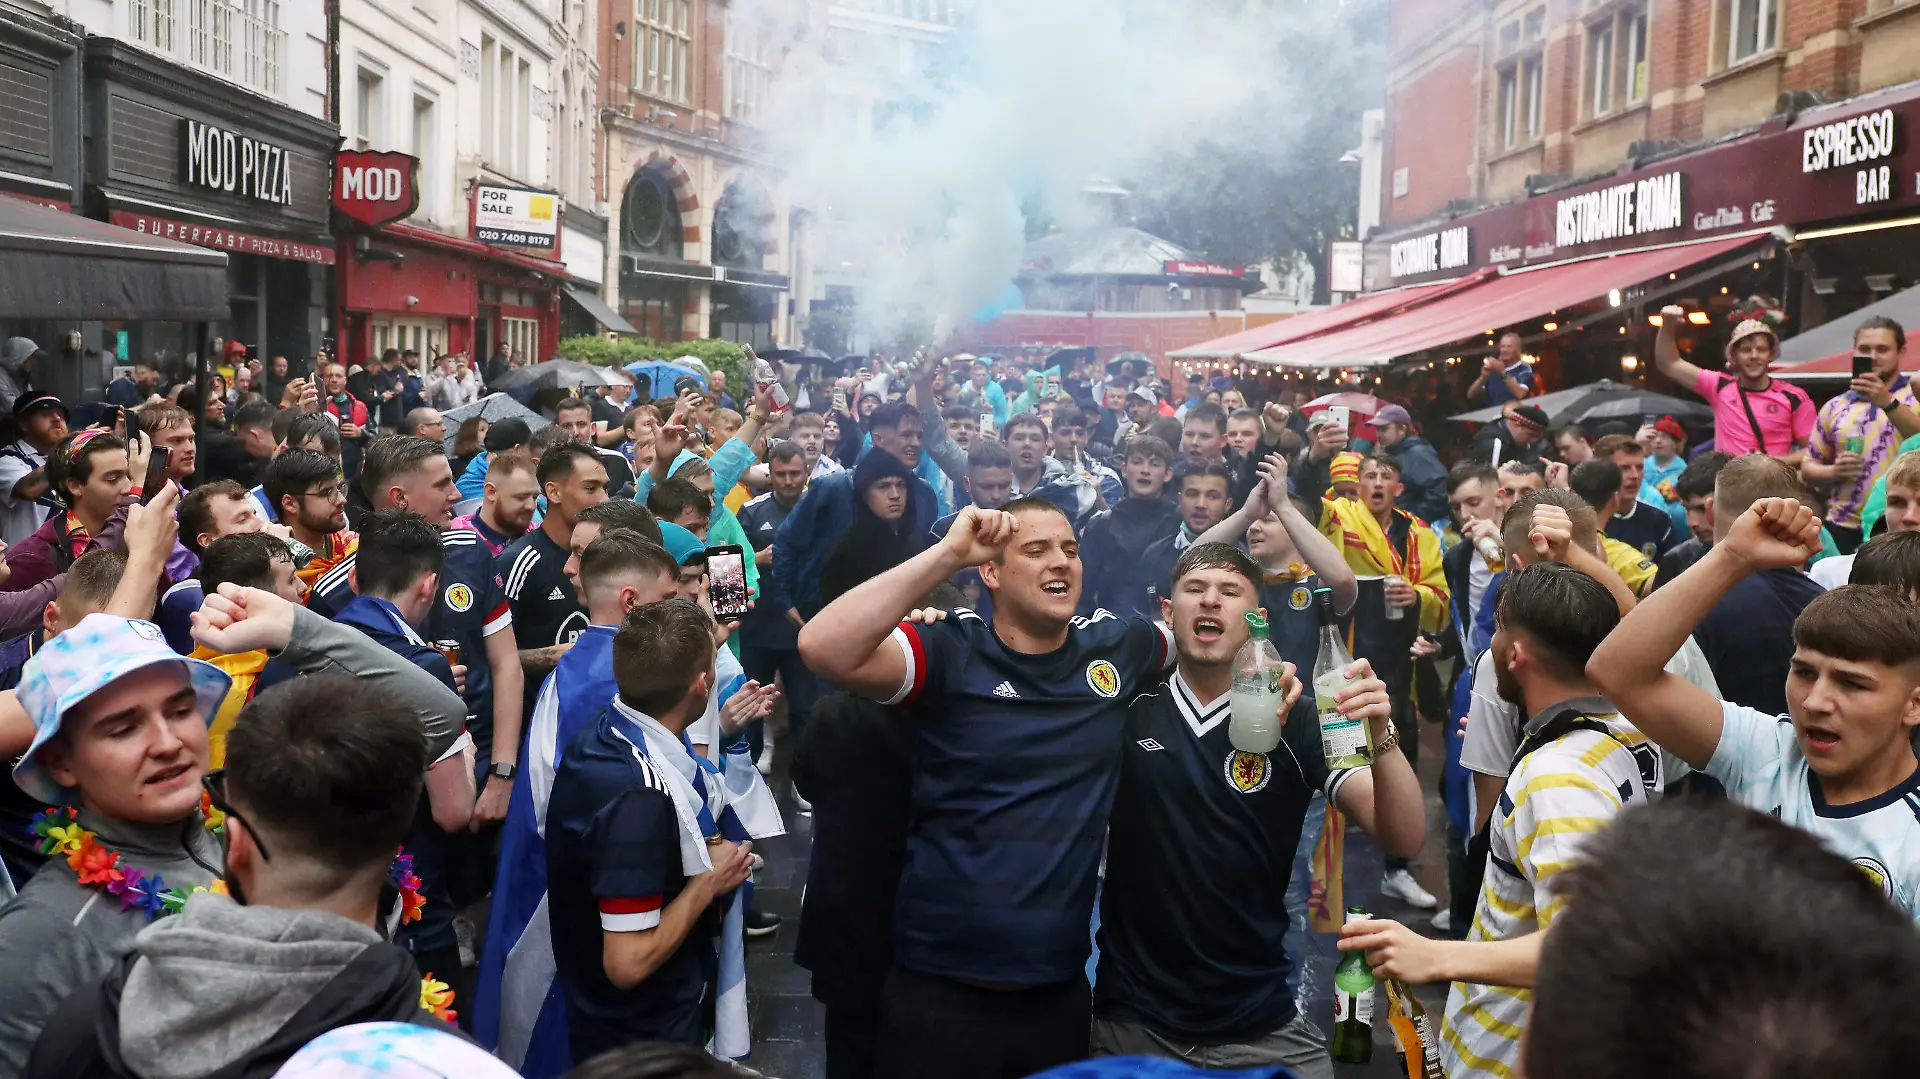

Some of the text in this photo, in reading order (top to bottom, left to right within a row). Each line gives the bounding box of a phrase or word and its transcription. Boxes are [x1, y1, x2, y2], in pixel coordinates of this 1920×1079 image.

[1803, 109, 1893, 173] ESPRESSO
[188, 120, 236, 192] MOD
[242, 137, 292, 206] PIZZA
[342, 166, 401, 201] MOD
[482, 190, 507, 201] FOR
[1856, 166, 1890, 204] BAR
[481, 203, 513, 214] SALE
[1556, 171, 1681, 247] RISTORANTE ROMA
[137, 219, 322, 261] SUPERFAST PIZZA & SALAD
[479, 230, 550, 246] 020 7409 8178
